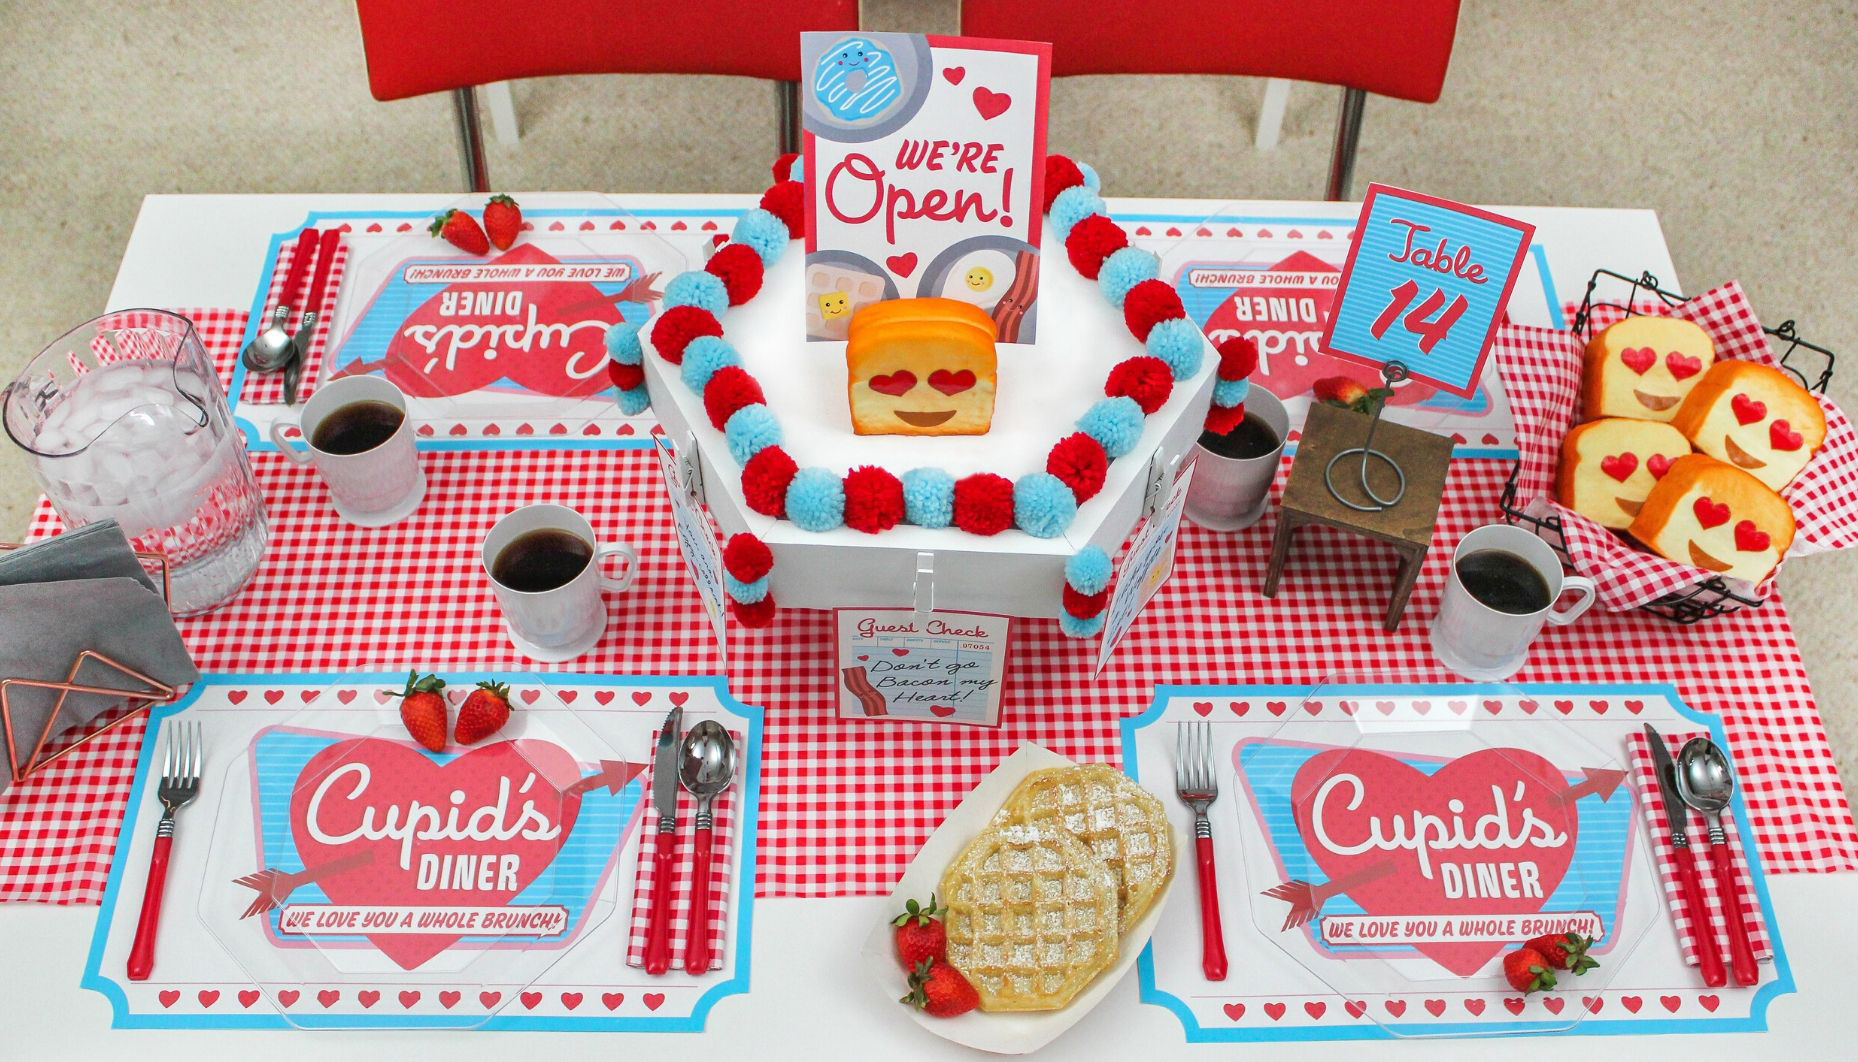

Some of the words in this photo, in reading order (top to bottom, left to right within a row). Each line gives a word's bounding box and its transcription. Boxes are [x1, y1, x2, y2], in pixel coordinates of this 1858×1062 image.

[895, 139, 1004, 173] WE'RE
[825, 152, 1014, 245] Open!
[1387, 218, 1489, 284] Table
[409, 267, 472, 280] BRUNCH!
[473, 267, 522, 279] WHOLE
[525, 267, 535, 278] A
[536, 267, 566, 278] YOU
[567, 267, 602, 278] LOVE
[604, 267, 625, 278] WE
[1195, 273, 1256, 284] BRUNCH!
[1259, 275, 1305, 285] WHOLE
[1309, 275, 1318, 285] A
[1321, 275, 1341, 286] OU
[438, 291, 523, 316] DINER
[1233, 296, 1318, 323] DINER
[1370, 279, 1469, 356] 14
[404, 303, 610, 380] Cupid's
[857, 618, 919, 638] Guest
[926, 620, 989, 638] Check
[870, 658, 941, 673] Don't
[945, 661, 980, 675] go
[876, 676, 953, 688] Bacon
[959, 679, 998, 690] my
[893, 690, 974, 703] Heart!
[306, 762, 562, 871] Cupid's
[1312, 773, 1568, 880] Cupid's
[416, 853, 521, 892] DINER
[1440, 861, 1544, 899] DINER
[286, 911, 315, 928] WE
[316, 911, 361, 928] LOVE
[361, 911, 399, 928] YOU
[400, 911, 415, 928] A
[417, 911, 479, 929] WHOLE
[481, 912, 563, 930] BRUNCH!
[1328, 921, 1354, 938] WE
[1359, 921, 1400, 938] LOVE
[1404, 920, 1438, 937] YOU
[1442, 920, 1454, 937] A
[1459, 919, 1516, 937] WHOLE
[1521, 918, 1595, 936] BRUNCH!
